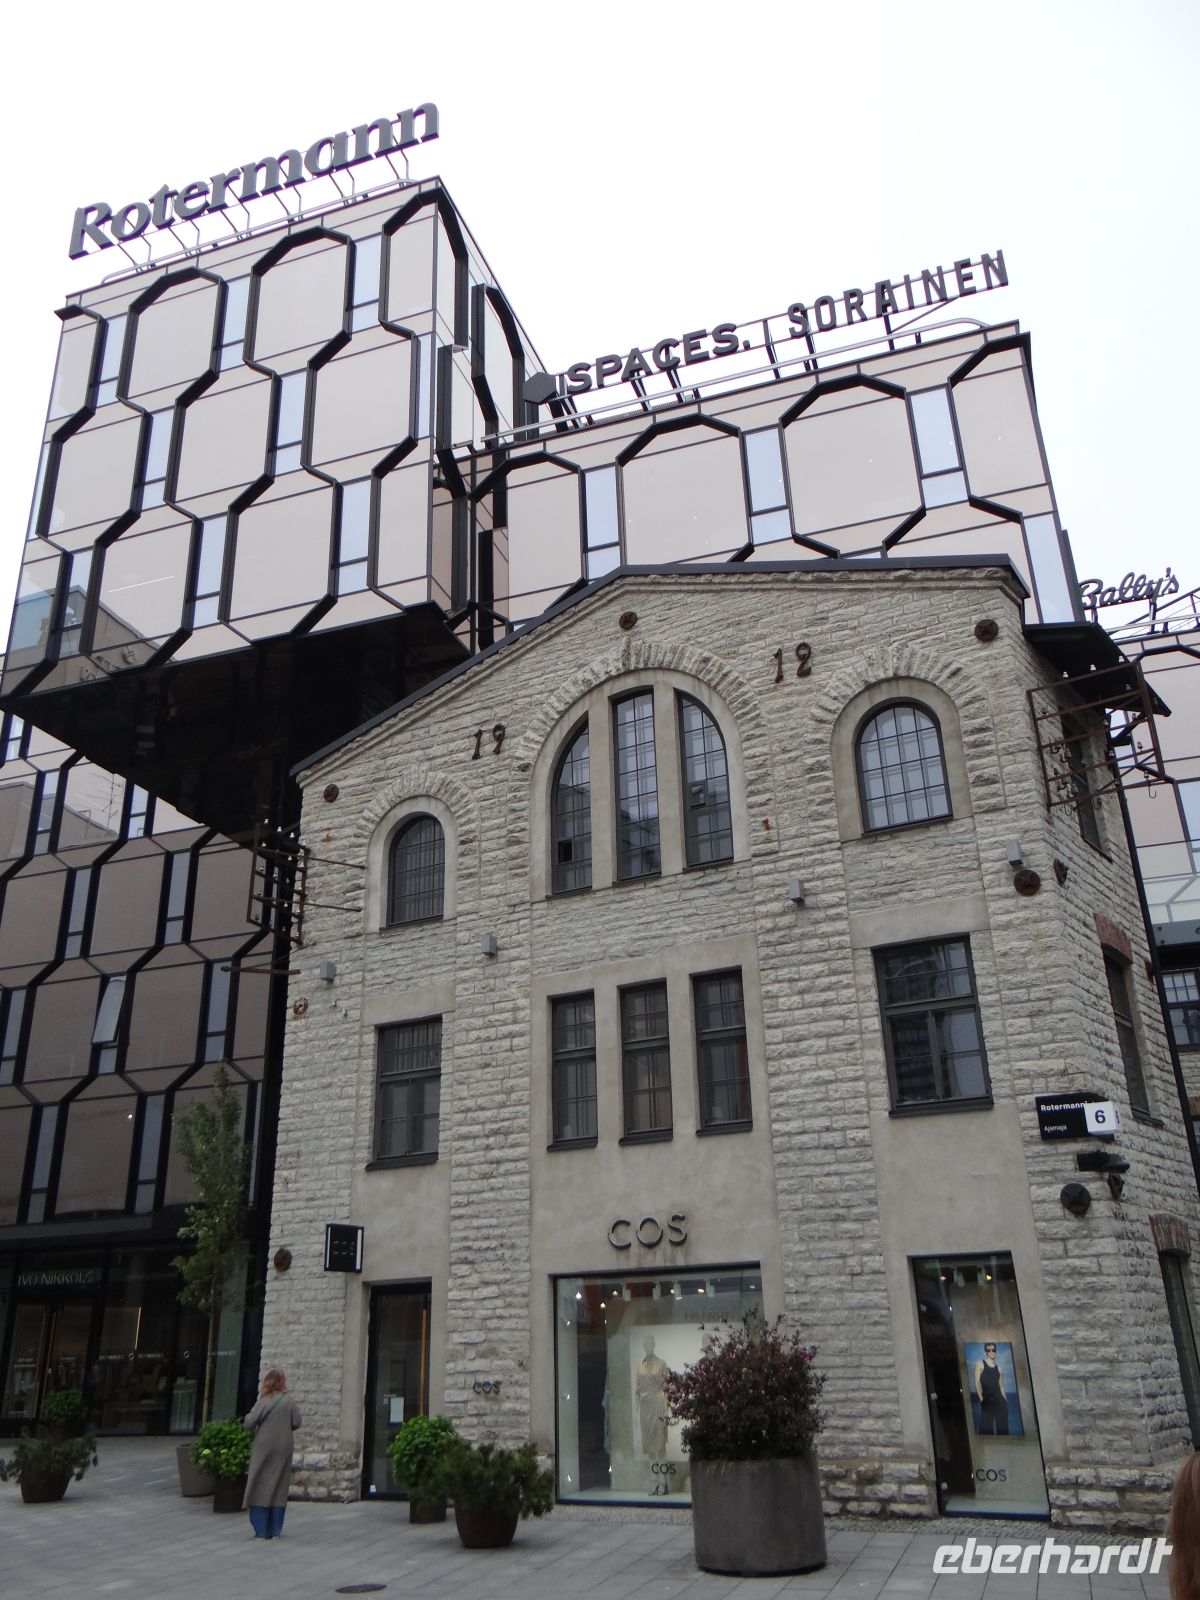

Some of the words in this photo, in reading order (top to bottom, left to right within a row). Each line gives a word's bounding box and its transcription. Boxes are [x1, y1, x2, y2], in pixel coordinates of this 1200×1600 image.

[68, 102, 440, 260] Rotermann
[787, 249, 1009, 339] SORAINEN
[1078, 567, 1180, 610] Bally's
[1094, 1110, 1106, 1124] 6
[607, 1214, 688, 1250] COS
[472, 1380, 502, 1394] COS
[651, 1463, 677, 1476] COS
[975, 1469, 1008, 1483] COS
